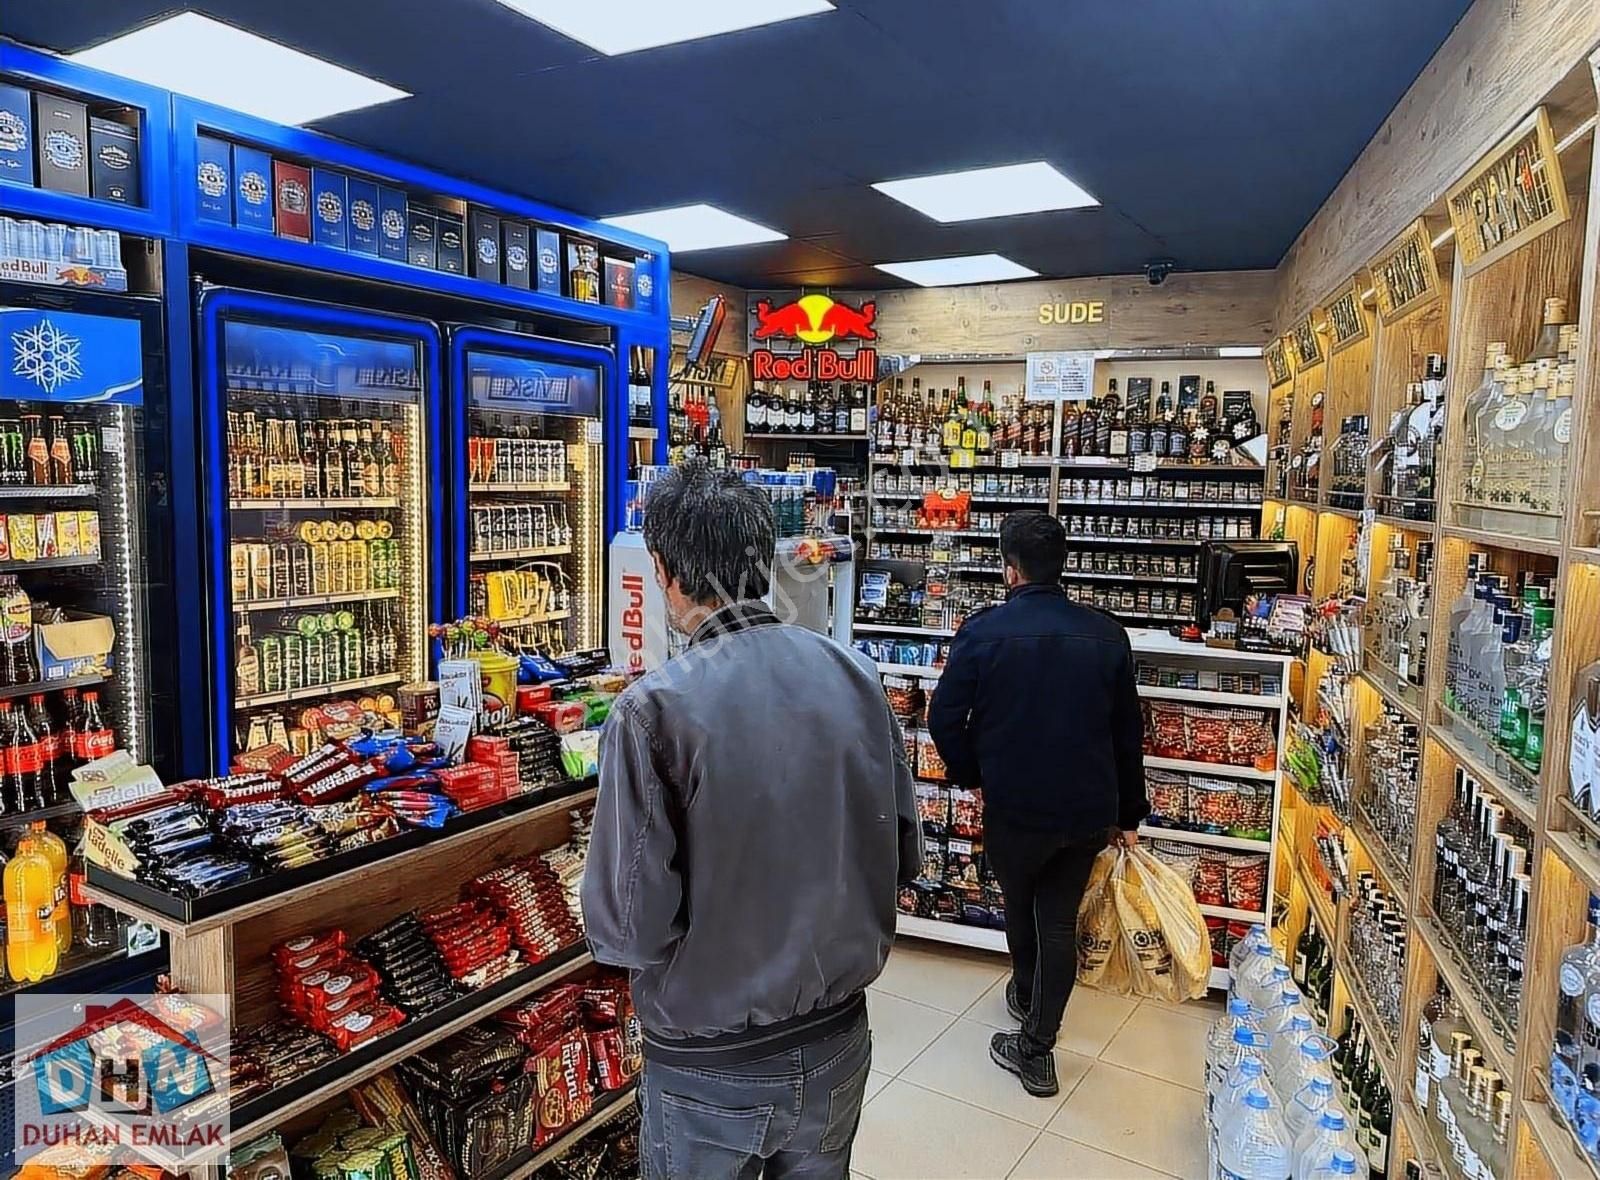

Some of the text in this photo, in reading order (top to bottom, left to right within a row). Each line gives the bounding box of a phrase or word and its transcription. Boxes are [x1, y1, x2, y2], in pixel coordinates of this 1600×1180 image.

[0, 259, 48, 275] ed Bull
[1038, 302, 1103, 324] SUDE
[753, 349, 876, 381] Red Bull
[621, 573, 644, 629] Bull
[87, 782, 161, 809] tadelle
[86, 827, 127, 871] tadelle
